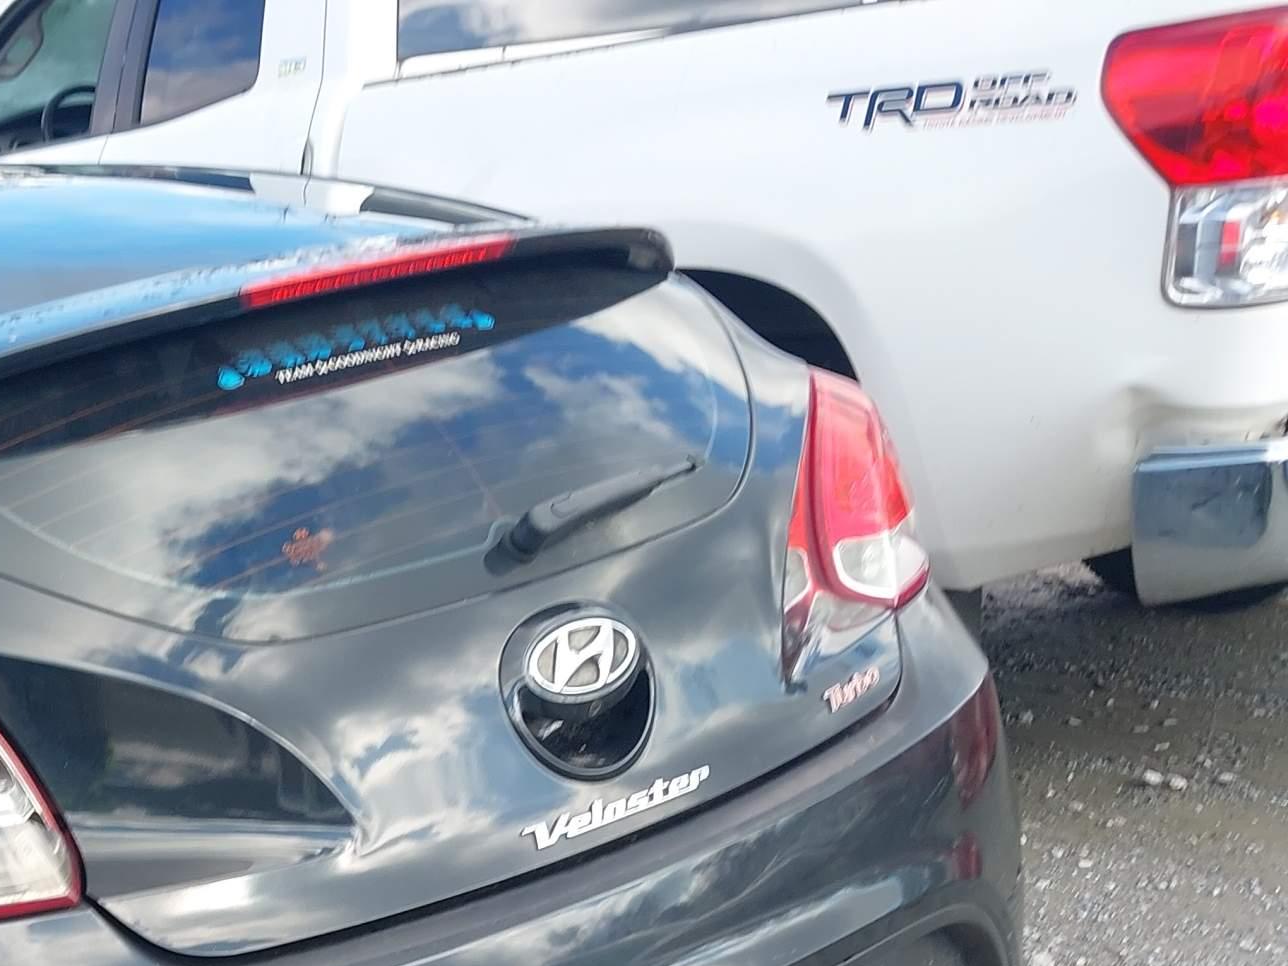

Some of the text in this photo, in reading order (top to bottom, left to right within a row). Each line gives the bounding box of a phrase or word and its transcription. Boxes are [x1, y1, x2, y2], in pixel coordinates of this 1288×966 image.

[972, 71, 1050, 91] OFF
[827, 81, 965, 131] TRD
[968, 89, 1077, 111] ROAD
